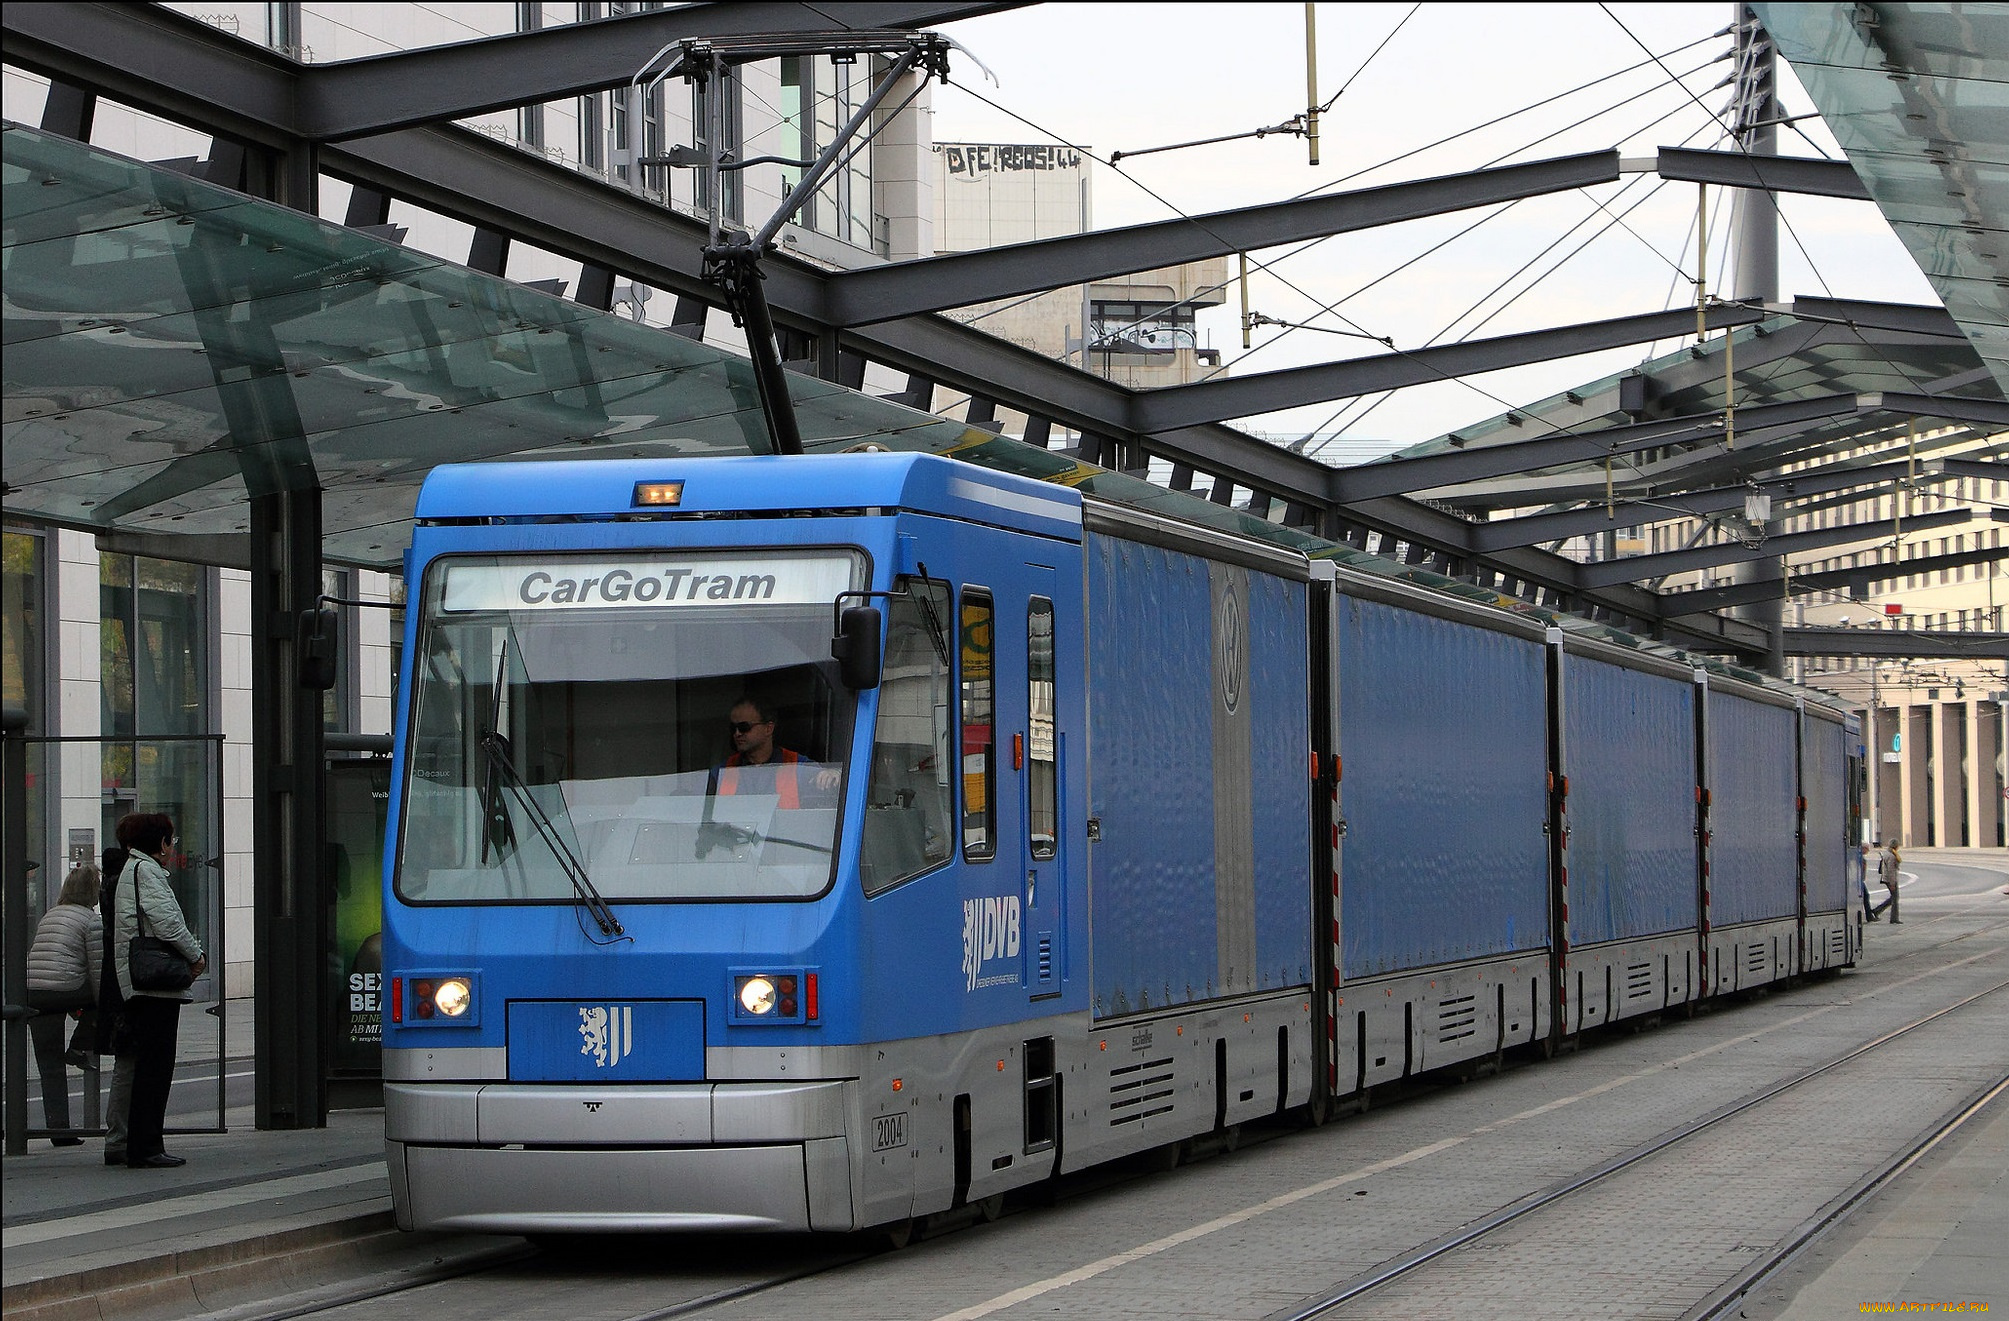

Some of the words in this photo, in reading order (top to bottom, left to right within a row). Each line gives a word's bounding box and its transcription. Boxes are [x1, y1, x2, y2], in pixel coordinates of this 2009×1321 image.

[519, 567, 776, 604] CarGoTram
[983, 895, 1020, 960] DVB
[350, 1024, 364, 1034] AB
[877, 1115, 903, 1147] 2004
